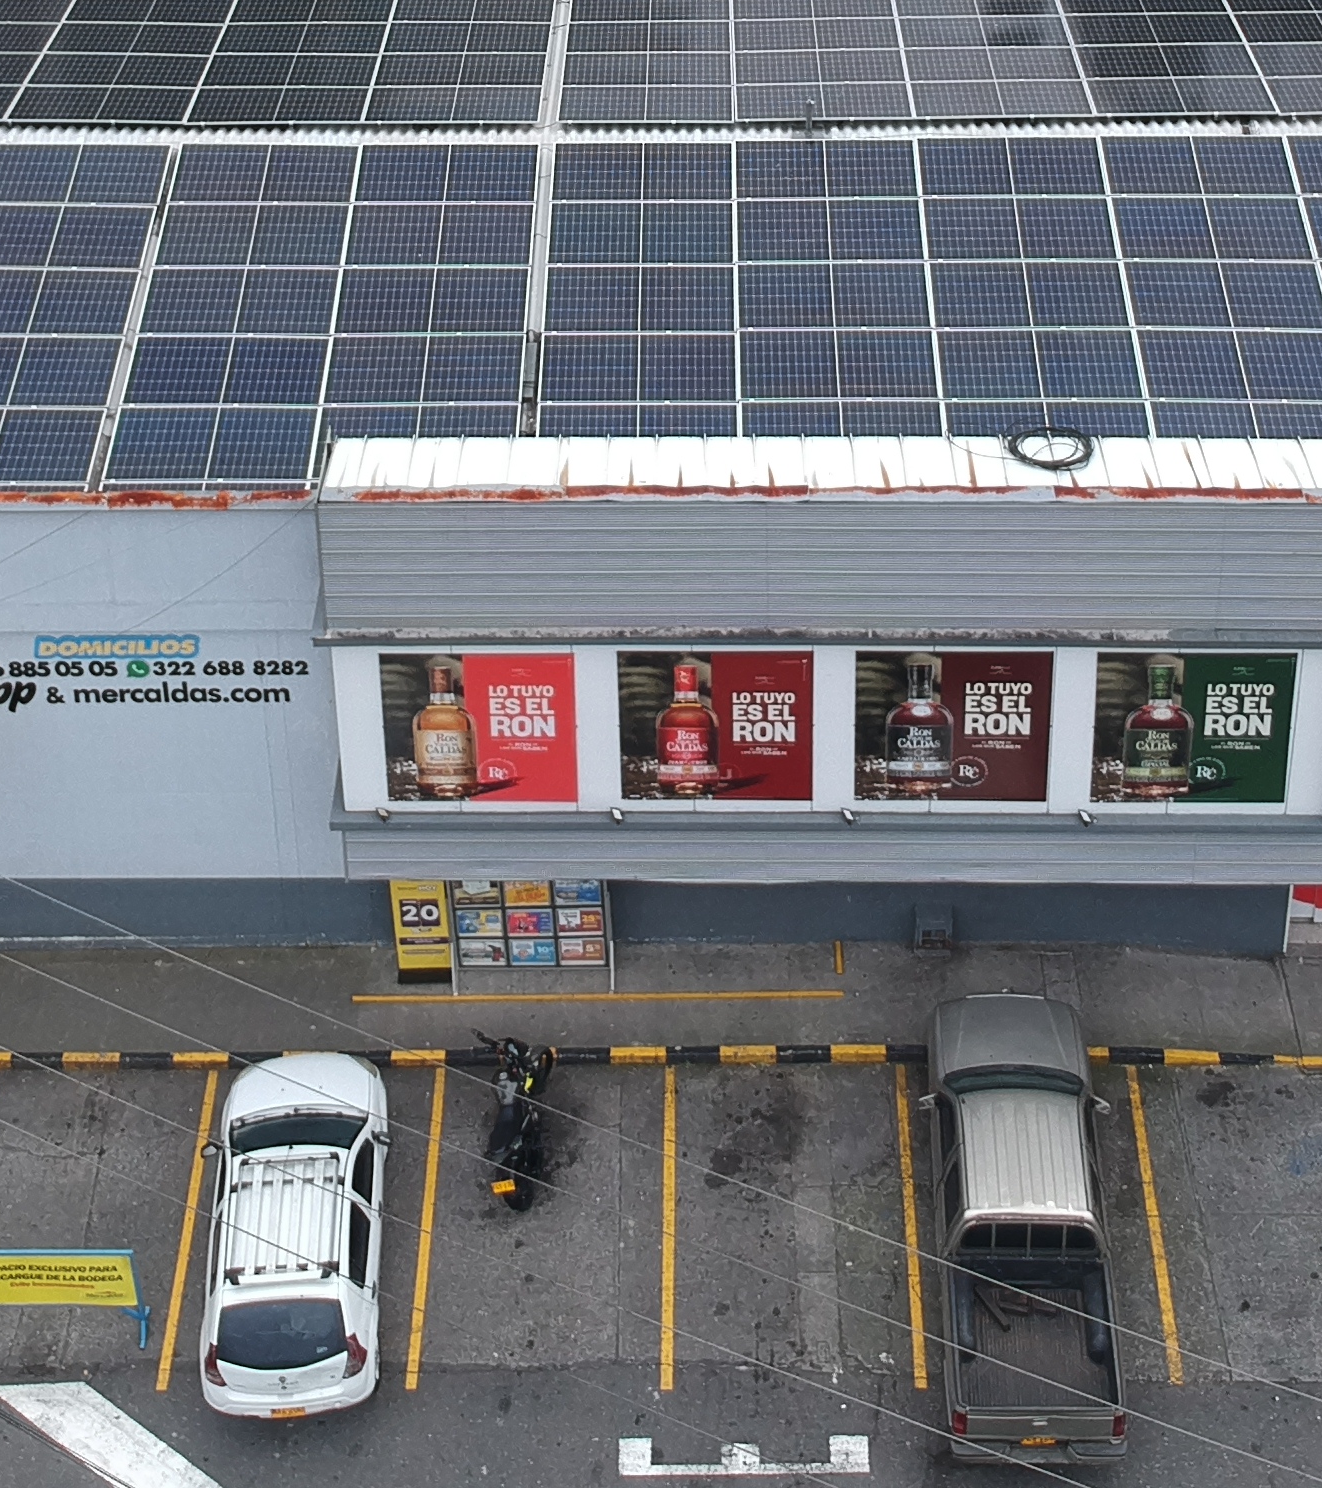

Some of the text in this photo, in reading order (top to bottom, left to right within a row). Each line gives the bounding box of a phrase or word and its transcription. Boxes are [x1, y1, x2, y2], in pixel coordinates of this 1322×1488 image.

[37, 637, 198, 658] DOMICILIOS
[9, 661, 51, 677] 885
[55, 661, 84, 677] 05
[89, 661, 118, 676] 05
[153, 660, 196, 676] 322
[203, 660, 244, 676] 688
[253, 660, 309, 676] 8282
[46, 687, 65, 704] &
[73, 681, 291, 704] mercaldas.com
[488, 685, 555, 697] LO TUYO
[965, 683, 1032, 695] LO TUYO
[1207, 684, 1275, 696] LO TUYO
[489, 698, 555, 715] ES EL
[732, 692, 796, 704] LO TUYO
[965, 696, 1031, 713] ES EL
[1206, 697, 1272, 714] ES EL
[733, 705, 795, 721] ES EL
[490, 716, 556, 738] RON
[732, 722, 796, 742] RON
[964, 714, 1031, 735] RON
[1204, 715, 1272, 736] RON
[666, 741, 709, 752] CALDAS
[897, 738, 941, 749] CALDAS
[1135, 740, 1178, 751] CALDAS
[402, 904, 439, 921] 20
[29, 1264, 87, 1273] EXCLUSIVO
[78, 1274, 124, 1282] BODEGA
